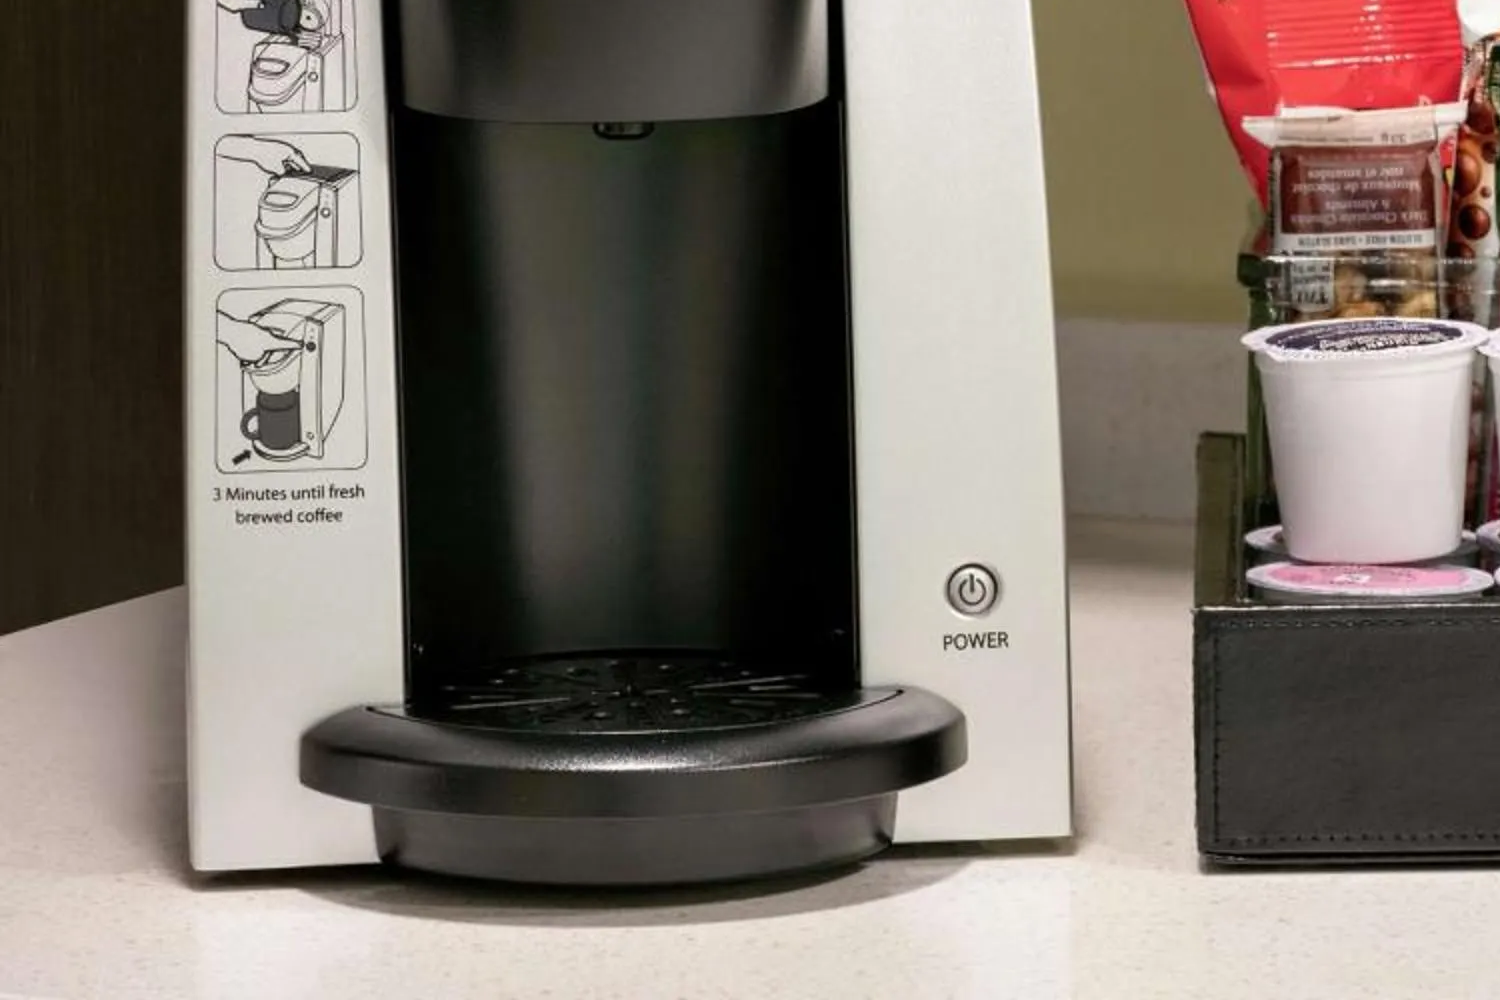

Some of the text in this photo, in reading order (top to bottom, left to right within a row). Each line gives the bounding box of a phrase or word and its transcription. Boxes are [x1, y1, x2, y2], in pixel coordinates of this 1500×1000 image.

[213, 483, 365, 501] 3 Minutes until fresh
[235, 507, 343, 525] brewed coffee
[943, 631, 1009, 651] POWER
